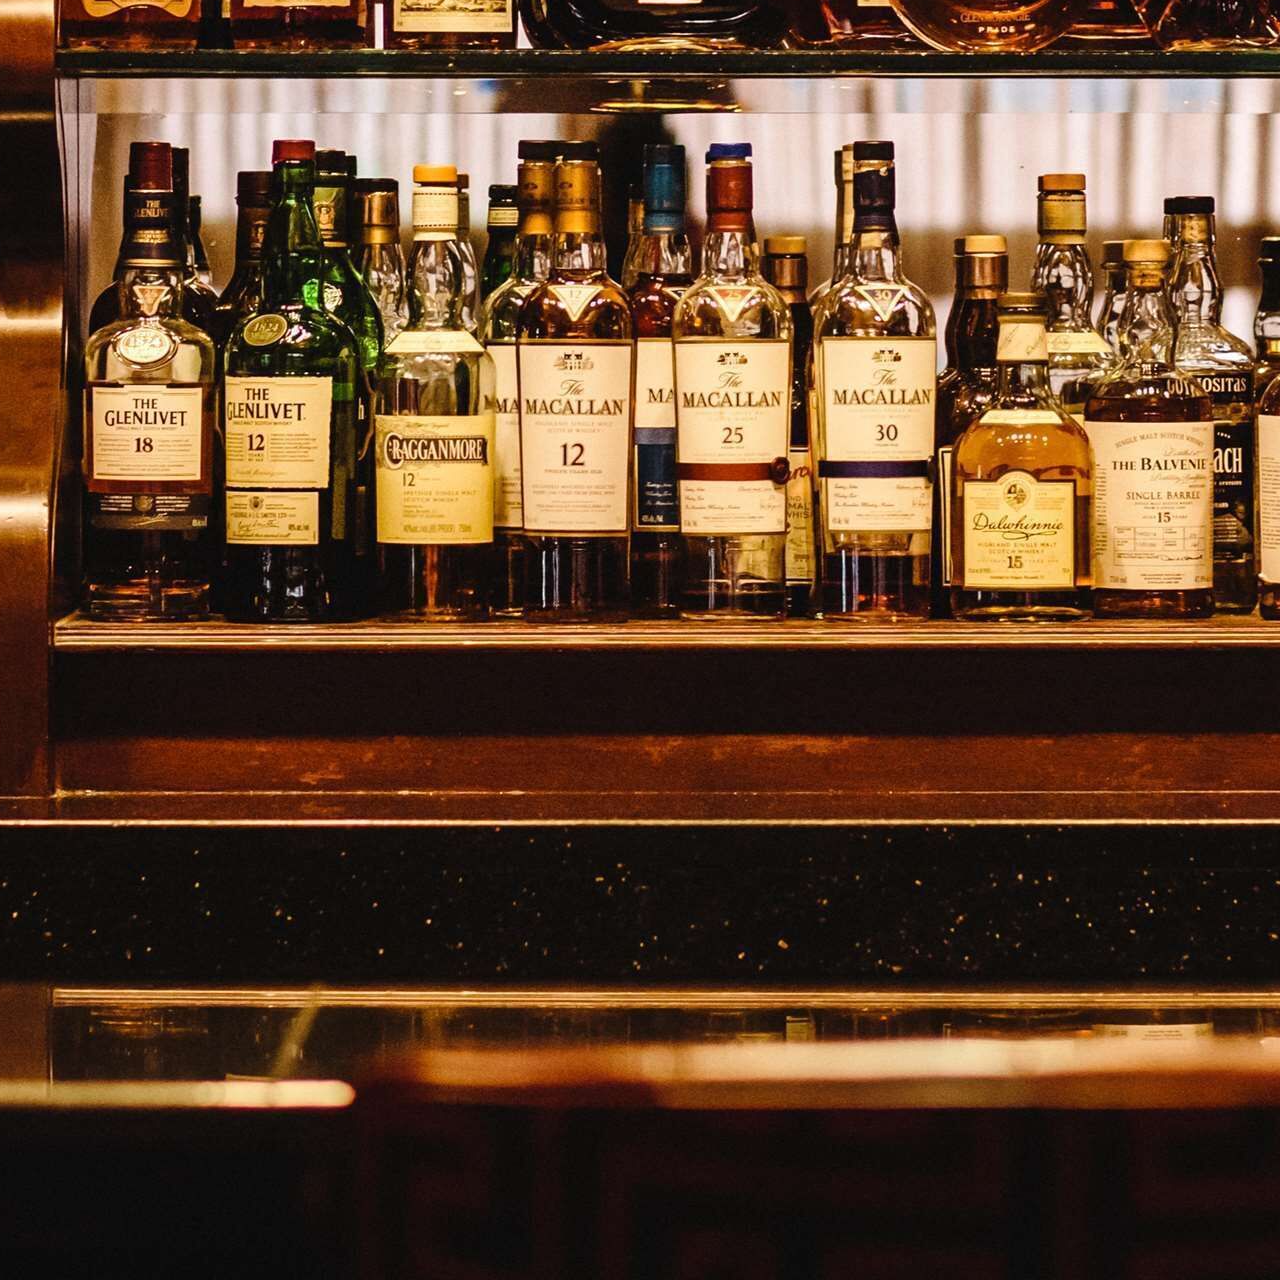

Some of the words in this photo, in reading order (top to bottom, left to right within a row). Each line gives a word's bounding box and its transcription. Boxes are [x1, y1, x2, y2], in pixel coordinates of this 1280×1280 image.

[718, 371, 743, 389] The
[872, 368, 898, 387] The
[245, 388, 270, 401] THE
[559, 379, 586, 397] The
[833, 388, 932, 406] MACALLAN
[132, 398, 158, 410] THE
[525, 398, 624, 416] MACALLAN
[682, 391, 782, 409] MACALLAN
[104, 409, 188, 427] GLENLIVET
[227, 402, 305, 421] GLENLIVET
[721, 426, 744, 444] 25
[875, 423, 898, 441] 30
[134, 436, 154, 453] 18
[247, 434, 266, 452] 12
[383, 432, 484, 470] CRAGGANMORE
[560, 443, 586, 467] 12
[1111, 460, 1138, 471] THE
[1141, 457, 1208, 471] BALVENIE
[402, 472, 416, 488] 12
[1126, 490, 1161, 500] SINGLE
[1166, 490, 1200, 500] BARREL
[972, 512, 1064, 533] Dalwhinnie
[1156, 511, 1172, 524] 15
[1006, 555, 1024, 569] 15
